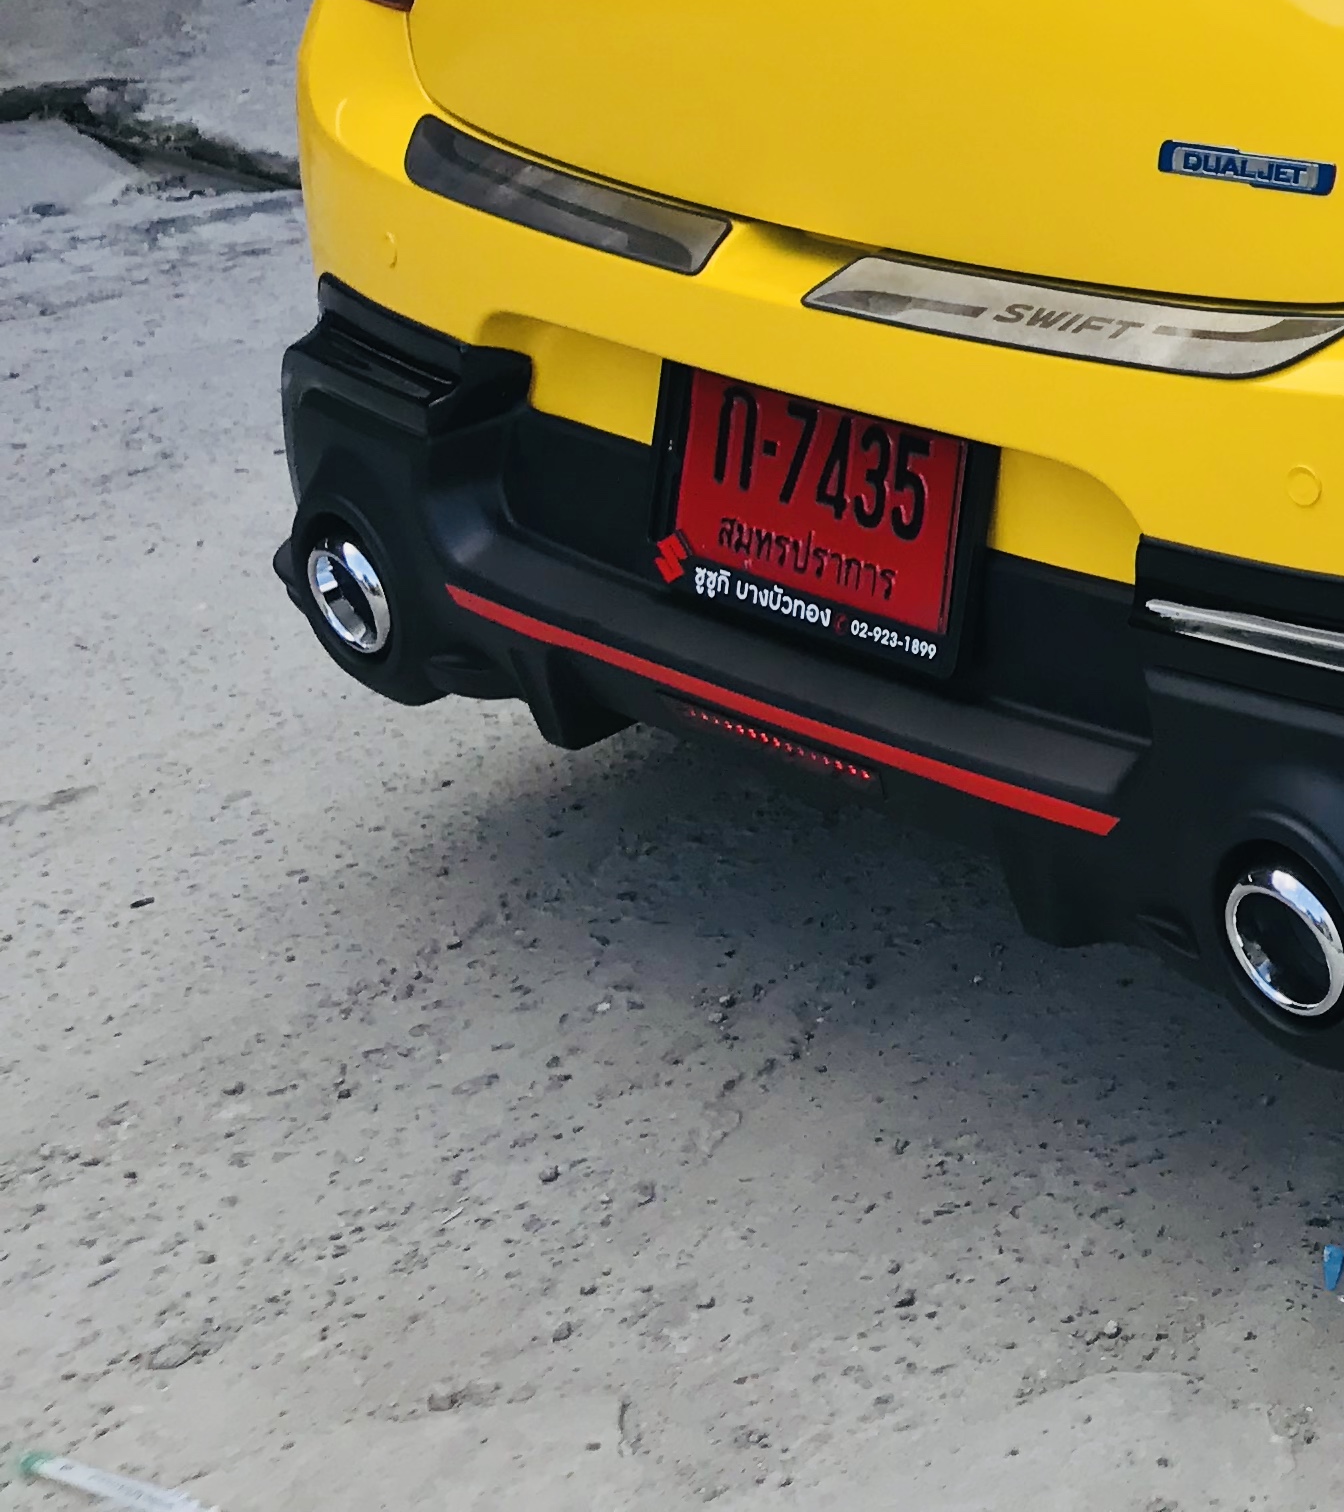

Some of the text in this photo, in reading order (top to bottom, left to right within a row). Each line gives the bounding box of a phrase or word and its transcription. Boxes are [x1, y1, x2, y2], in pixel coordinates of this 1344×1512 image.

[993, 302, 1145, 340] SWIFT
[717, 516, 898, 601] สมุทรปราการ
[850, 618, 938, 661] 02-923-1899
